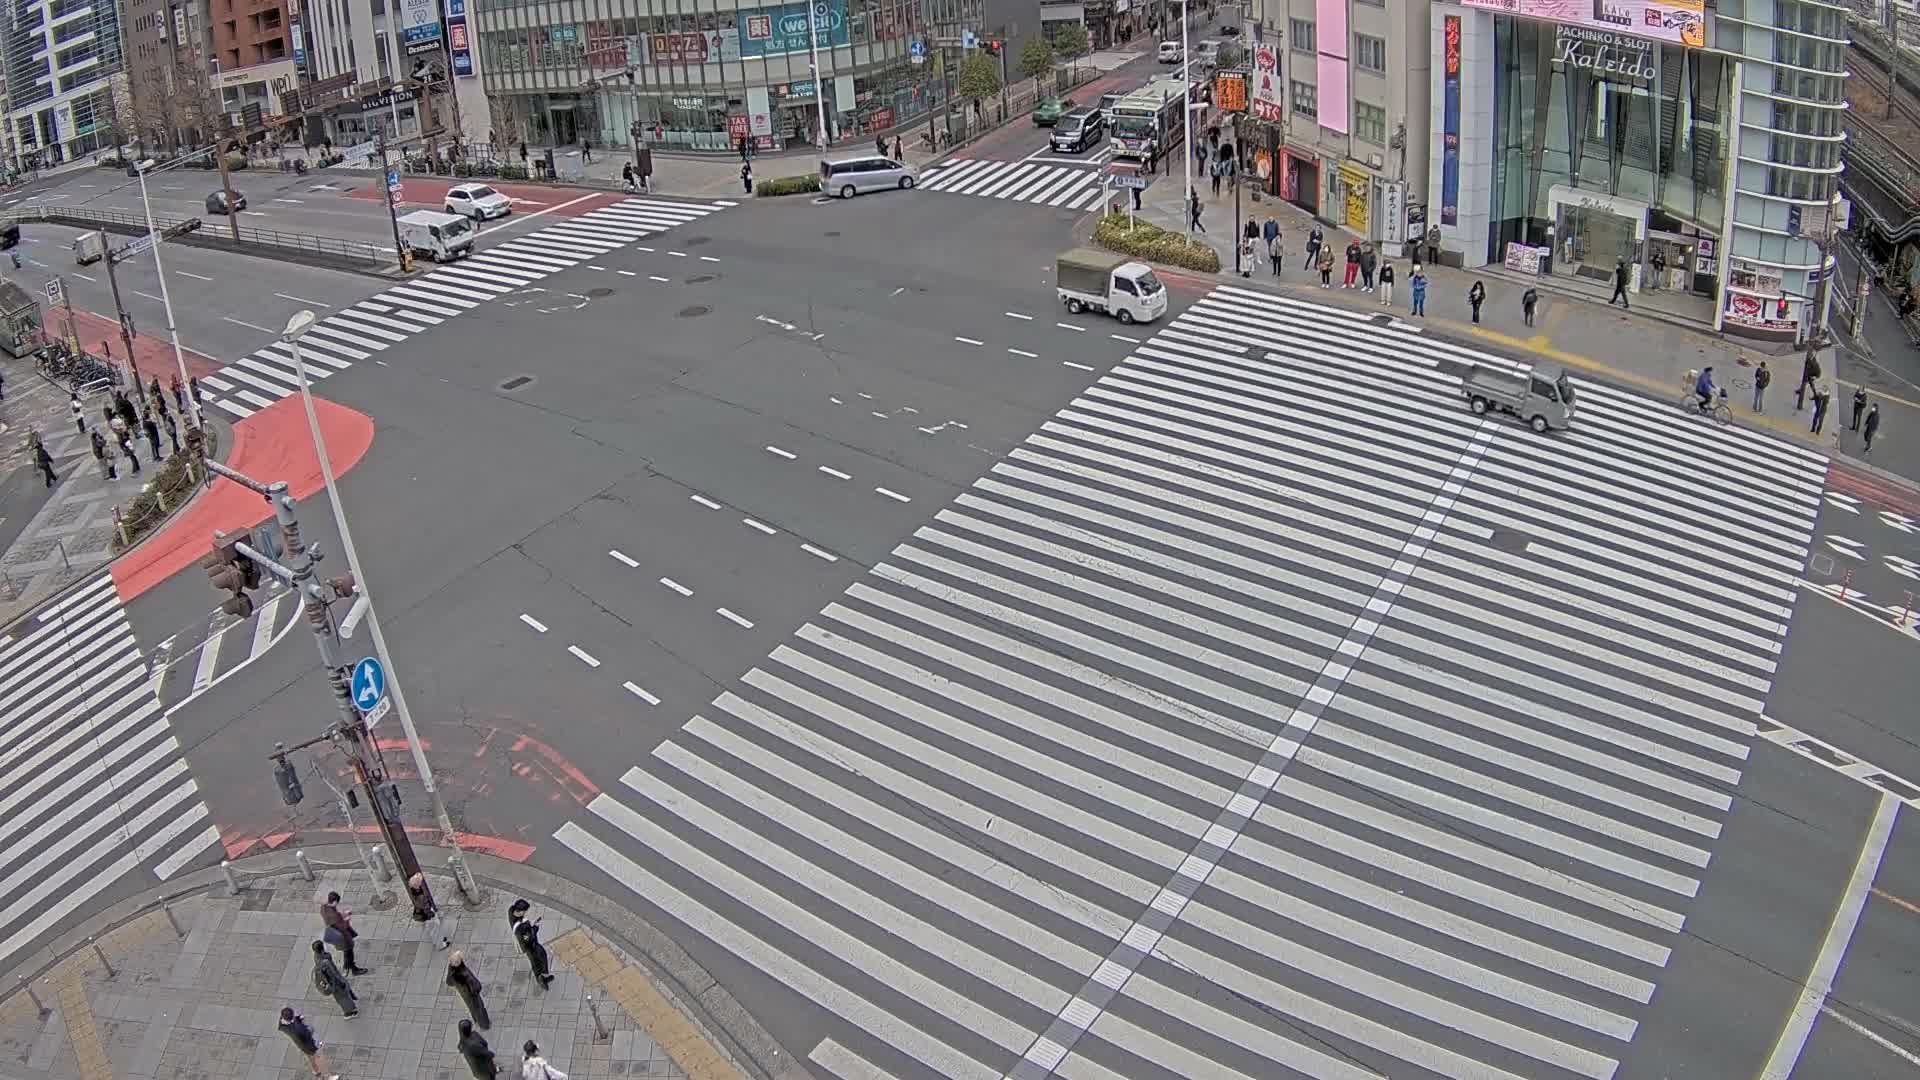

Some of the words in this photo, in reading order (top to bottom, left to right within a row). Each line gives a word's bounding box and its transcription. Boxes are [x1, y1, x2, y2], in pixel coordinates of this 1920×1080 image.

[765, 31, 827, 50] 処方せん付
[1556, 25, 1613, 44] PACHINKO
[1614, 36, 1623, 45] &
[1624, 37, 1651, 51] SLOT
[1551, 39, 1655, 80] Kaleido
[362, 90, 413, 109] IGVIION
